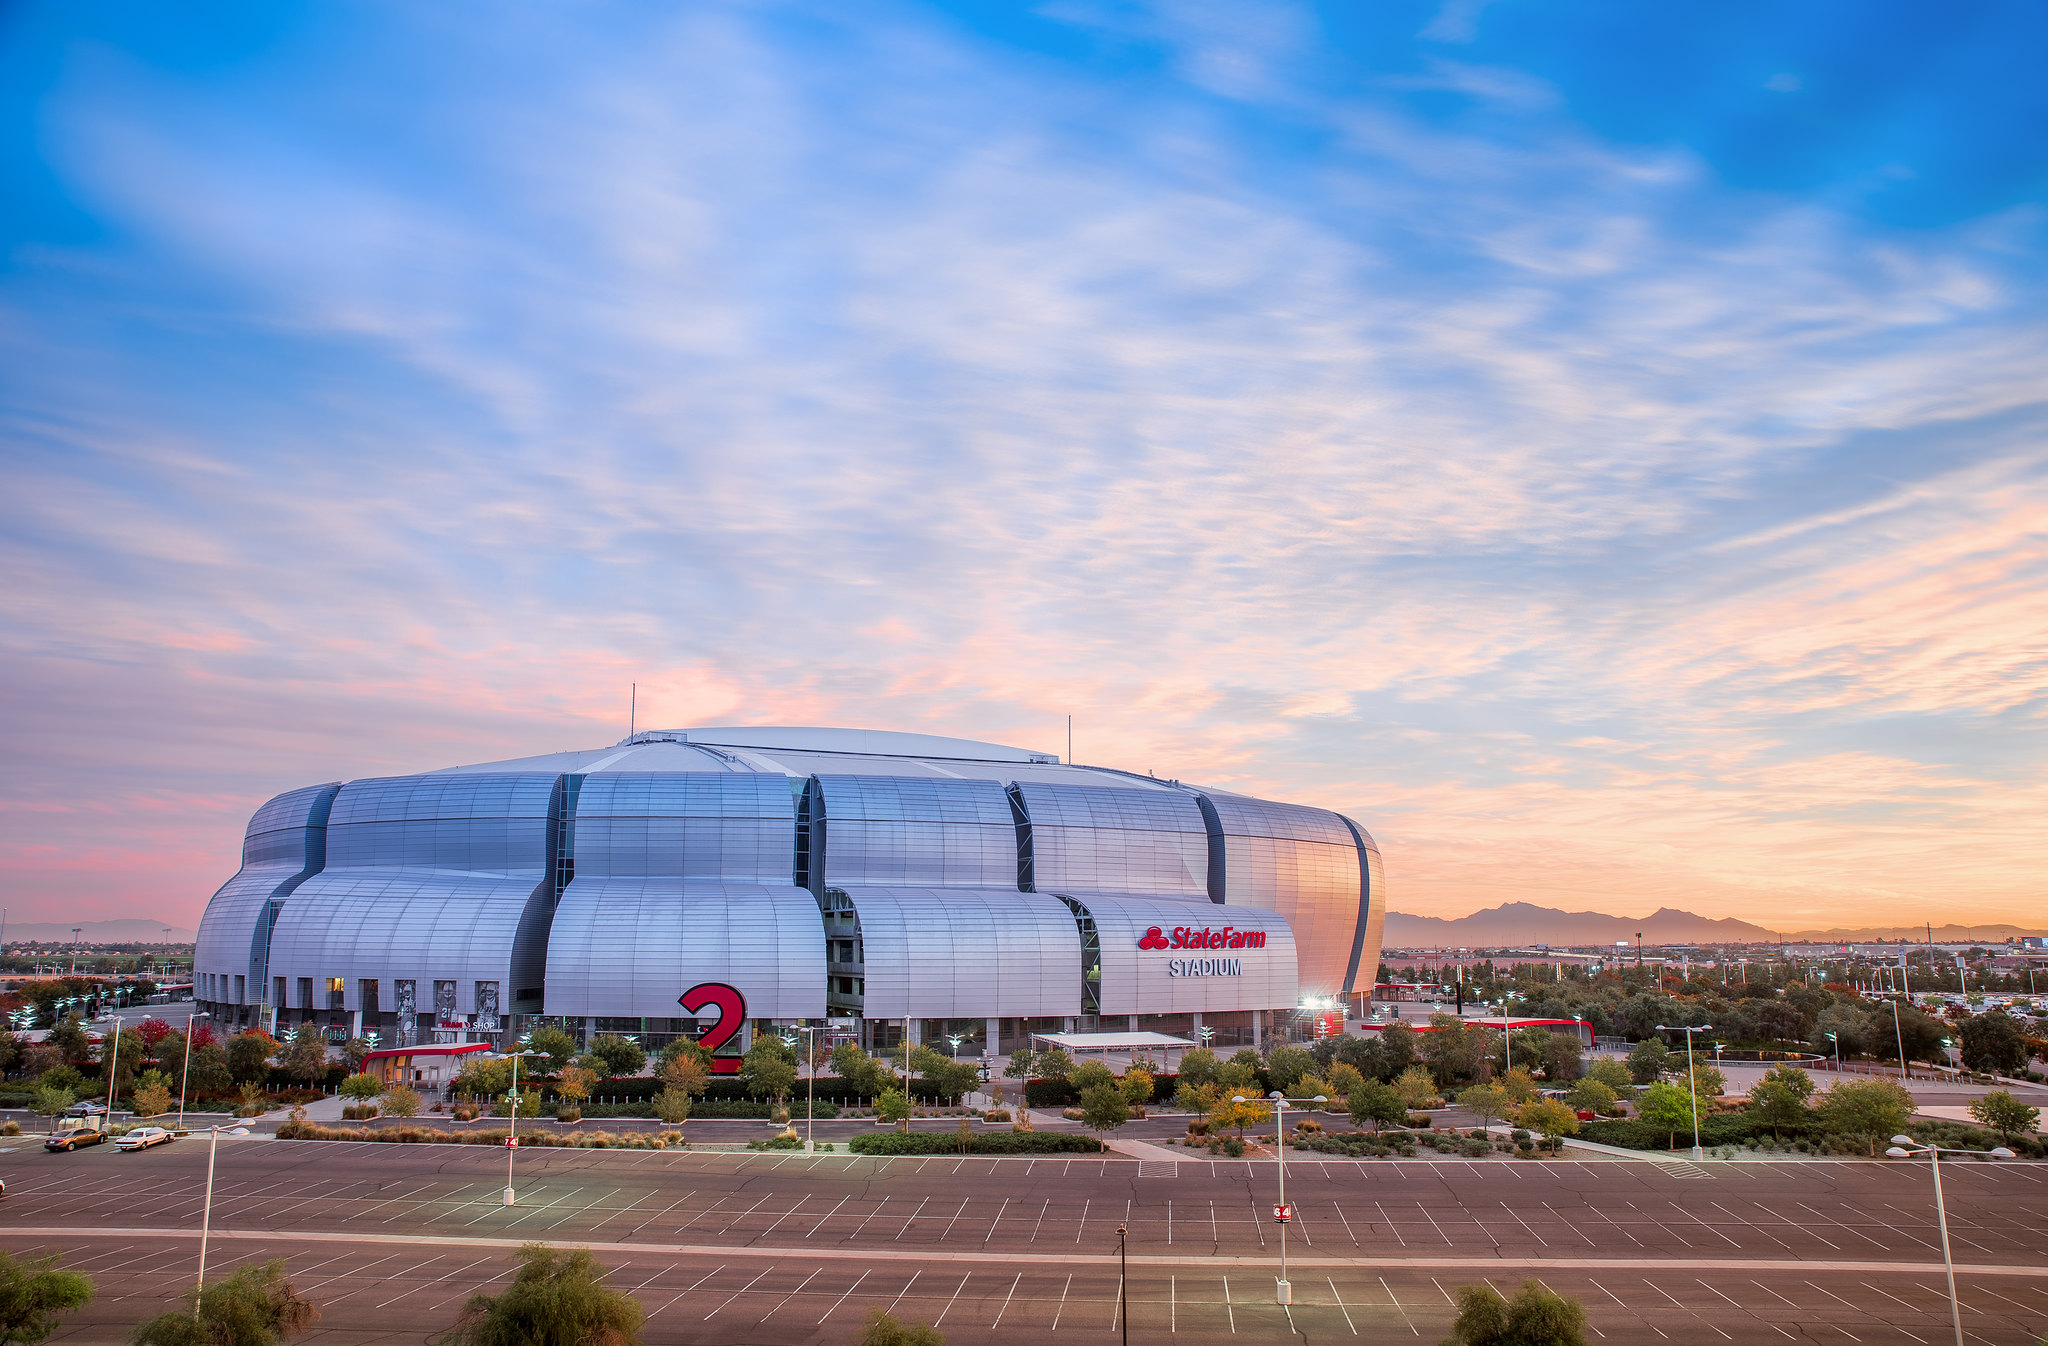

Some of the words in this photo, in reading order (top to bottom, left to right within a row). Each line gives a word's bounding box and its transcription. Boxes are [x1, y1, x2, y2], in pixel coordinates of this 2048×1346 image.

[1171, 926, 1266, 949] StateFarm
[1170, 958, 1242, 977] STADIUM
[441, 1007, 451, 1018] 21
[472, 1021, 495, 1030] SHOP
[677, 983, 748, 1076] 2
[1274, 1206, 1289, 1217] 64
